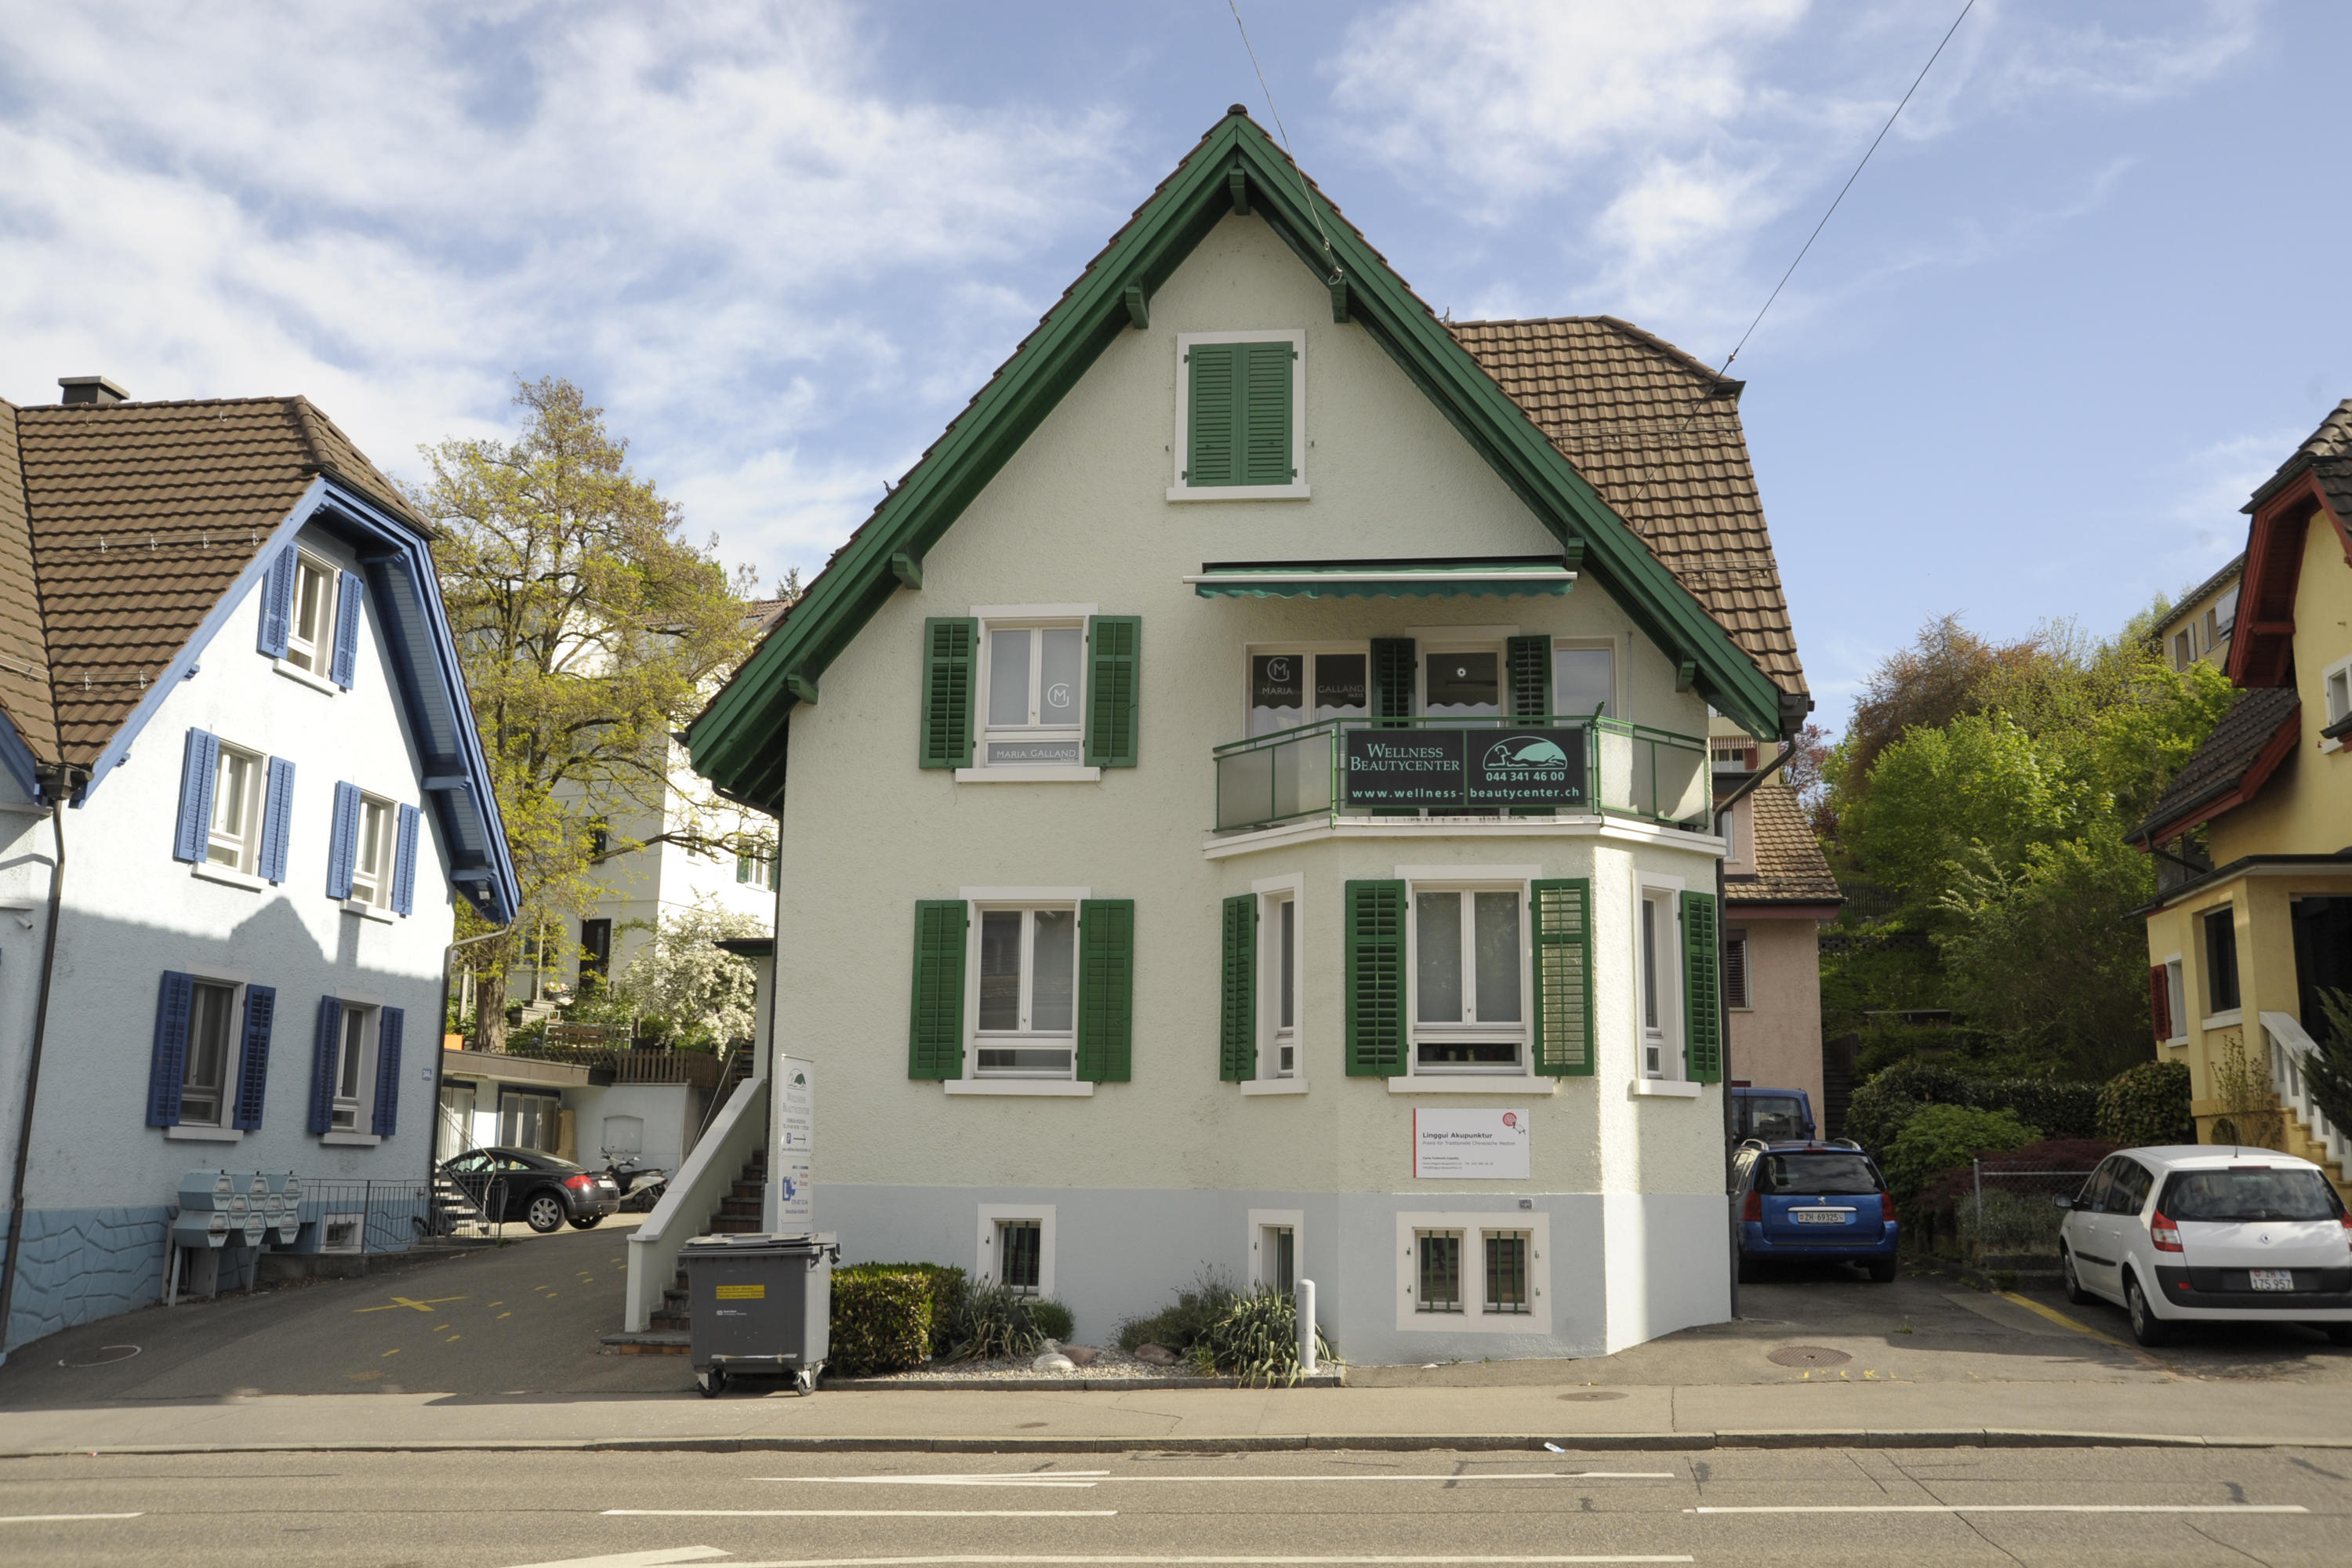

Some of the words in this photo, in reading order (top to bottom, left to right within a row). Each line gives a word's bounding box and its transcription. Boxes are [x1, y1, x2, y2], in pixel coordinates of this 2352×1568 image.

[996, 750, 1027, 759] MARIA
[1030, 749, 1076, 758] GALLAND
[1367, 743, 1443, 758] WELLNESS
[1350, 756, 1460, 771] BEAUTYCENTER
[1486, 771, 1507, 781] 044
[1510, 771, 1529, 781] 341
[1533, 771, 1548, 781] 46
[1550, 771, 1565, 781] 00
[1470, 787, 1579, 800] beautycenter.ch
